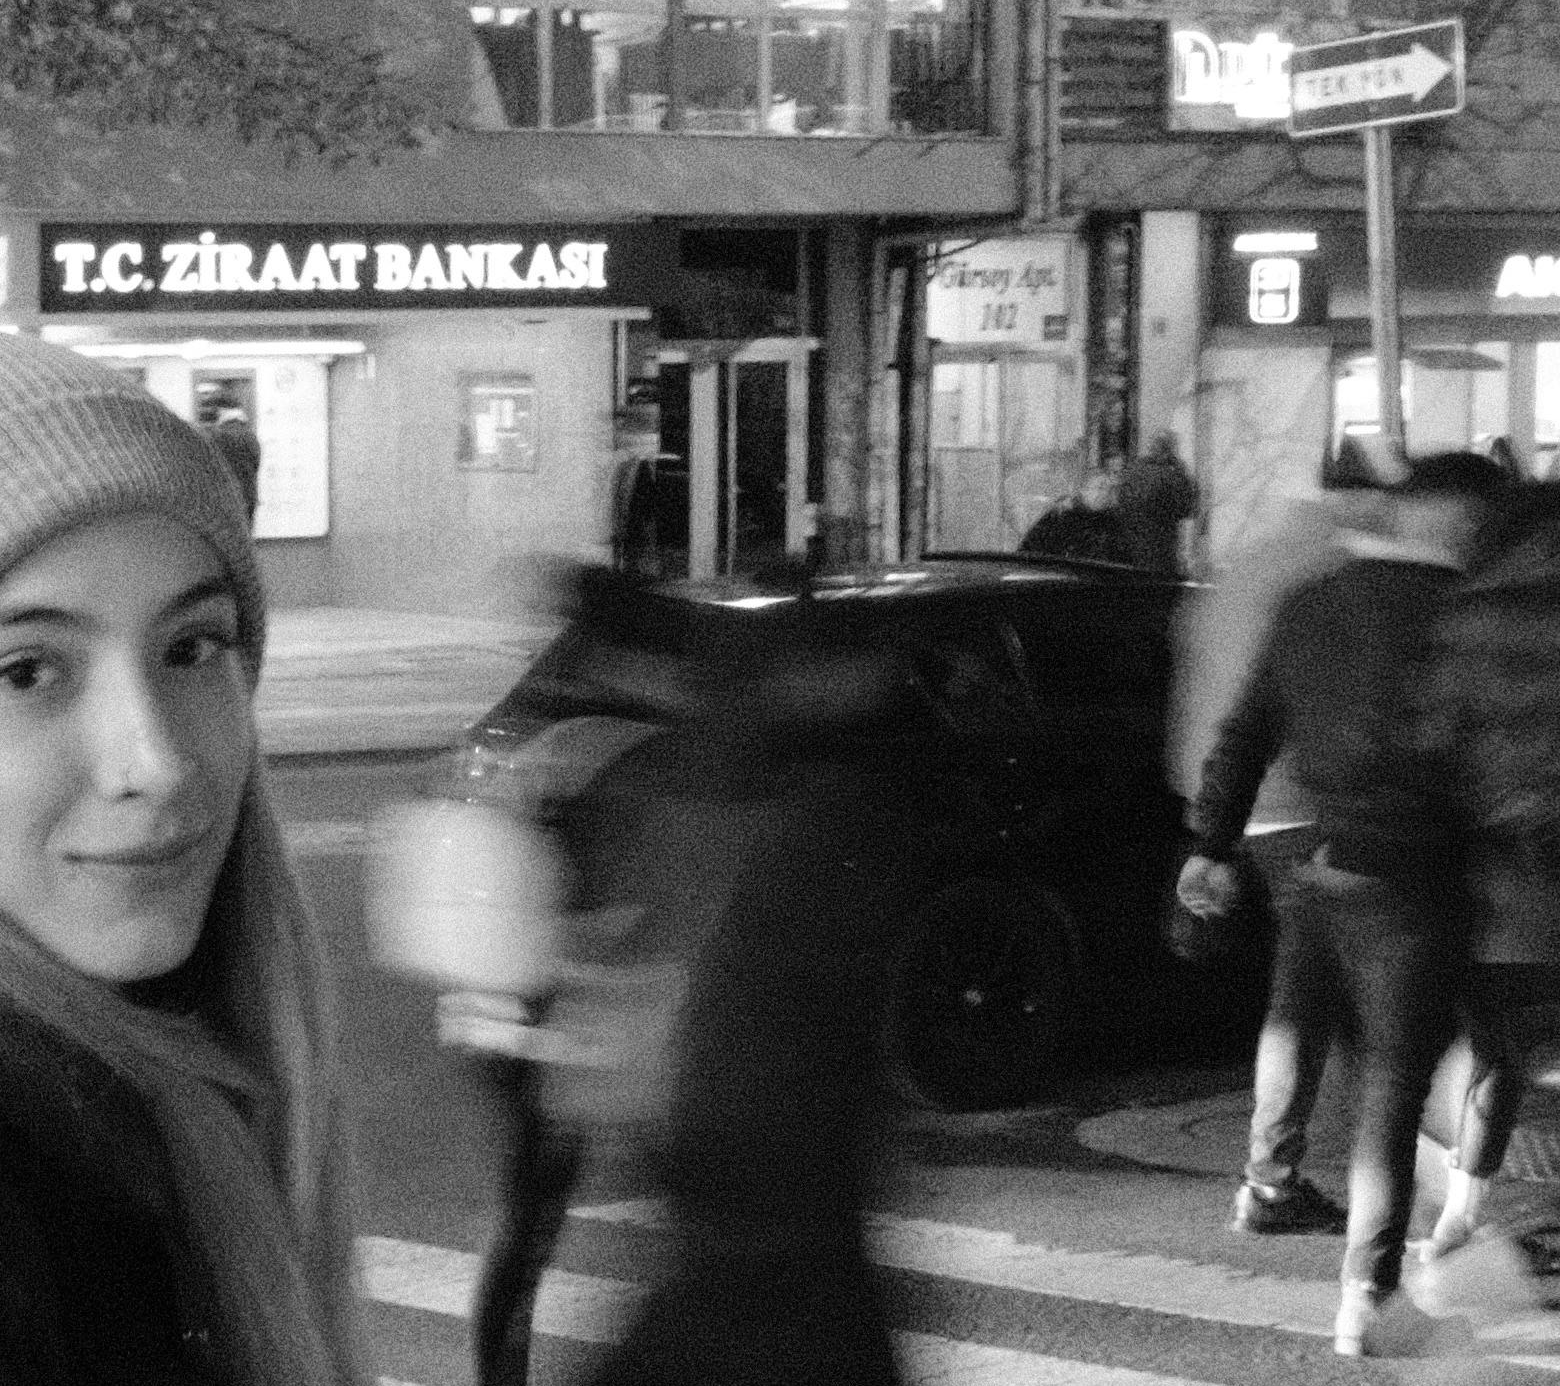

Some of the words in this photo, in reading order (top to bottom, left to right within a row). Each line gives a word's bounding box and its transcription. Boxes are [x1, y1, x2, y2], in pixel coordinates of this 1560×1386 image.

[53, 240, 155, 294] T.C.
[159, 230, 367, 293] ZİRAAT
[374, 241, 609, 291] BANKASI
